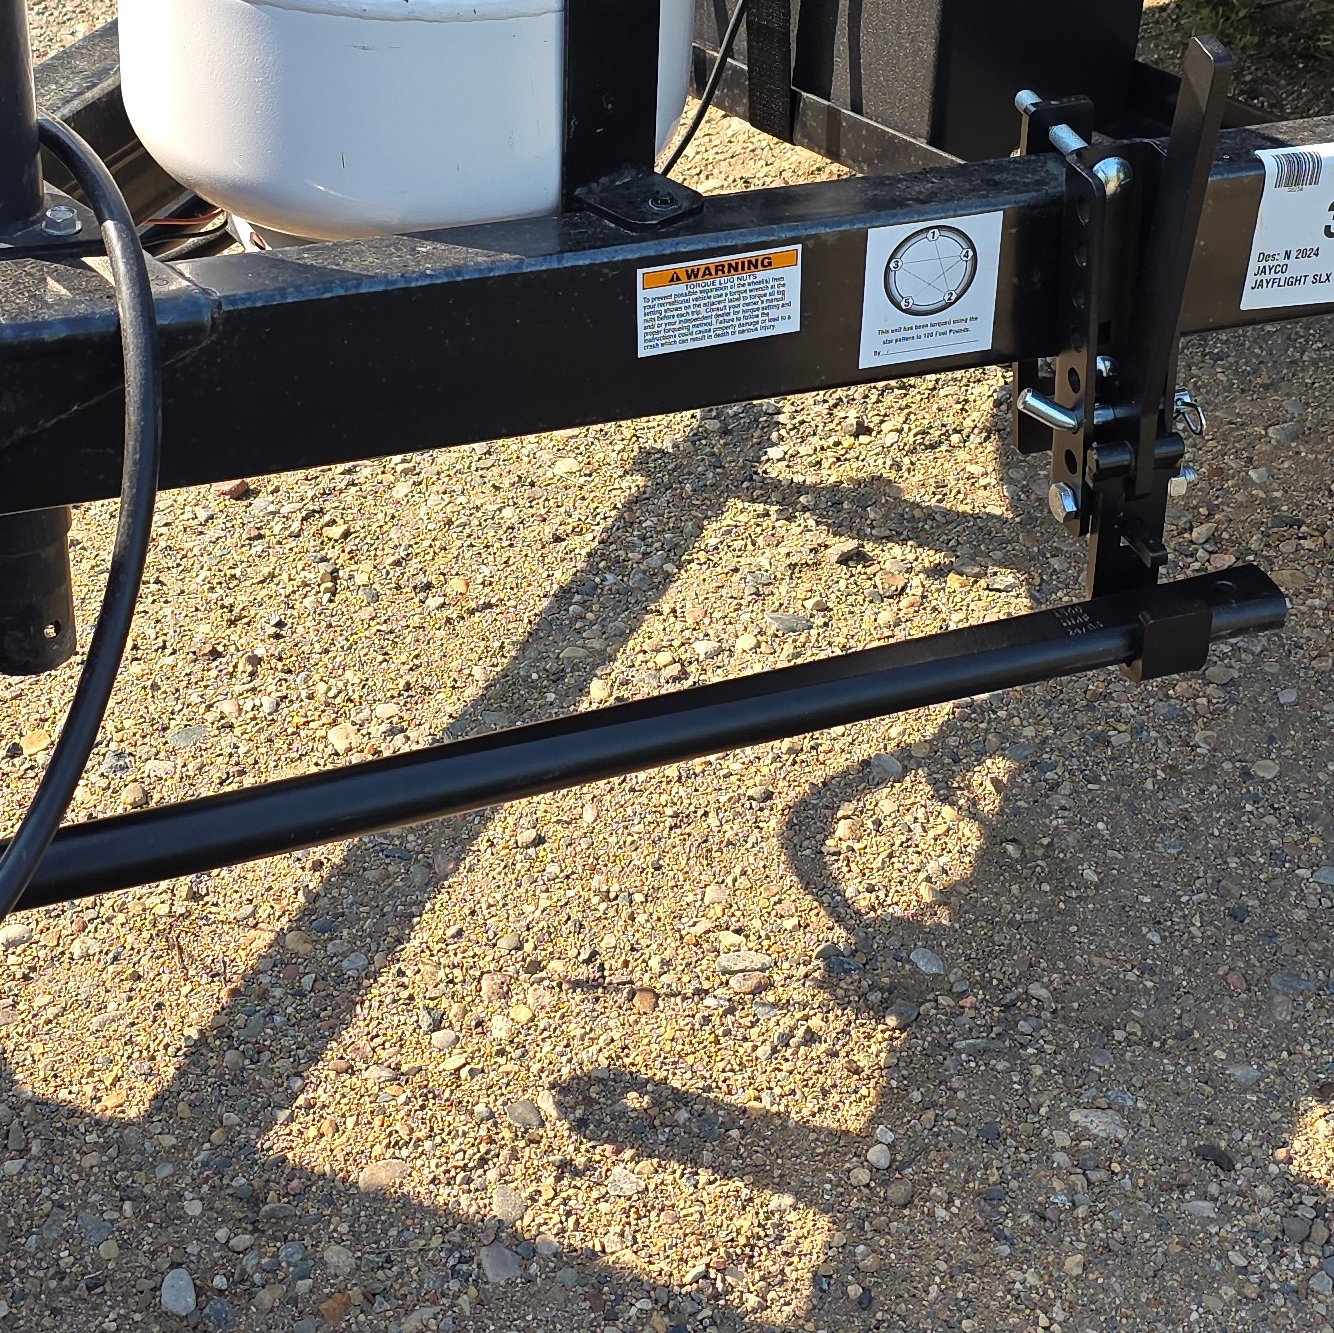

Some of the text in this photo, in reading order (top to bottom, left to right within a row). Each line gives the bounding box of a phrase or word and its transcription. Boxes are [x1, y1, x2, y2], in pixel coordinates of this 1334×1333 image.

[930, 230, 936, 240] 1
[892, 250, 970, 269] 3 4
[1258, 248, 1320, 263] Des: N 2024
[685, 256, 772, 280] WARNING
[1254, 264, 1288, 276] JAYCO
[685, 280, 716, 290] TORQUE
[737, 274, 758, 282] NUTS
[1250, 274, 1309, 290] JAYFLIGHT
[1312, 272, 1332, 286] SLX
[904, 298, 910, 307] 5
